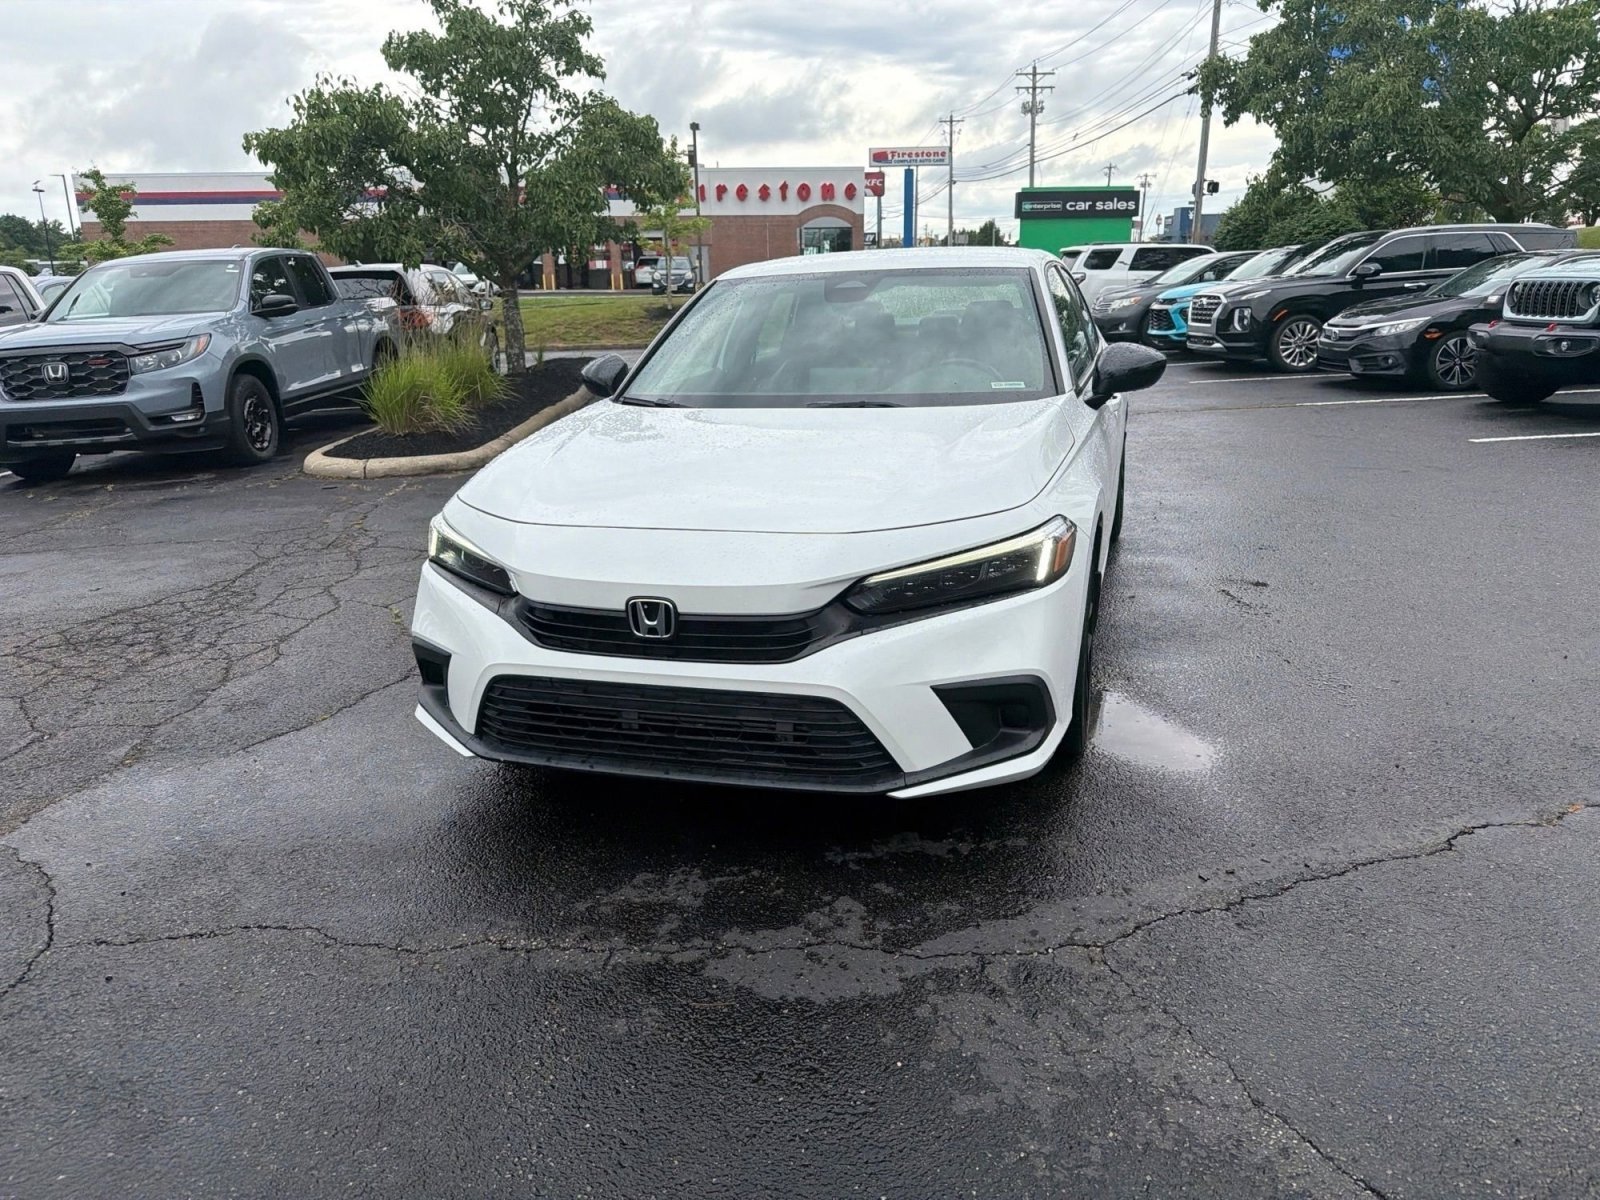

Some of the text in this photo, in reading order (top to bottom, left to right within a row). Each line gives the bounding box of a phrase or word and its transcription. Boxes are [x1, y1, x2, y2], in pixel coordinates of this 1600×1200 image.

[890, 151, 946, 159] Firestone
[684, 180, 858, 202] irestone
[1023, 197, 1136, 211] enterprise car sales
